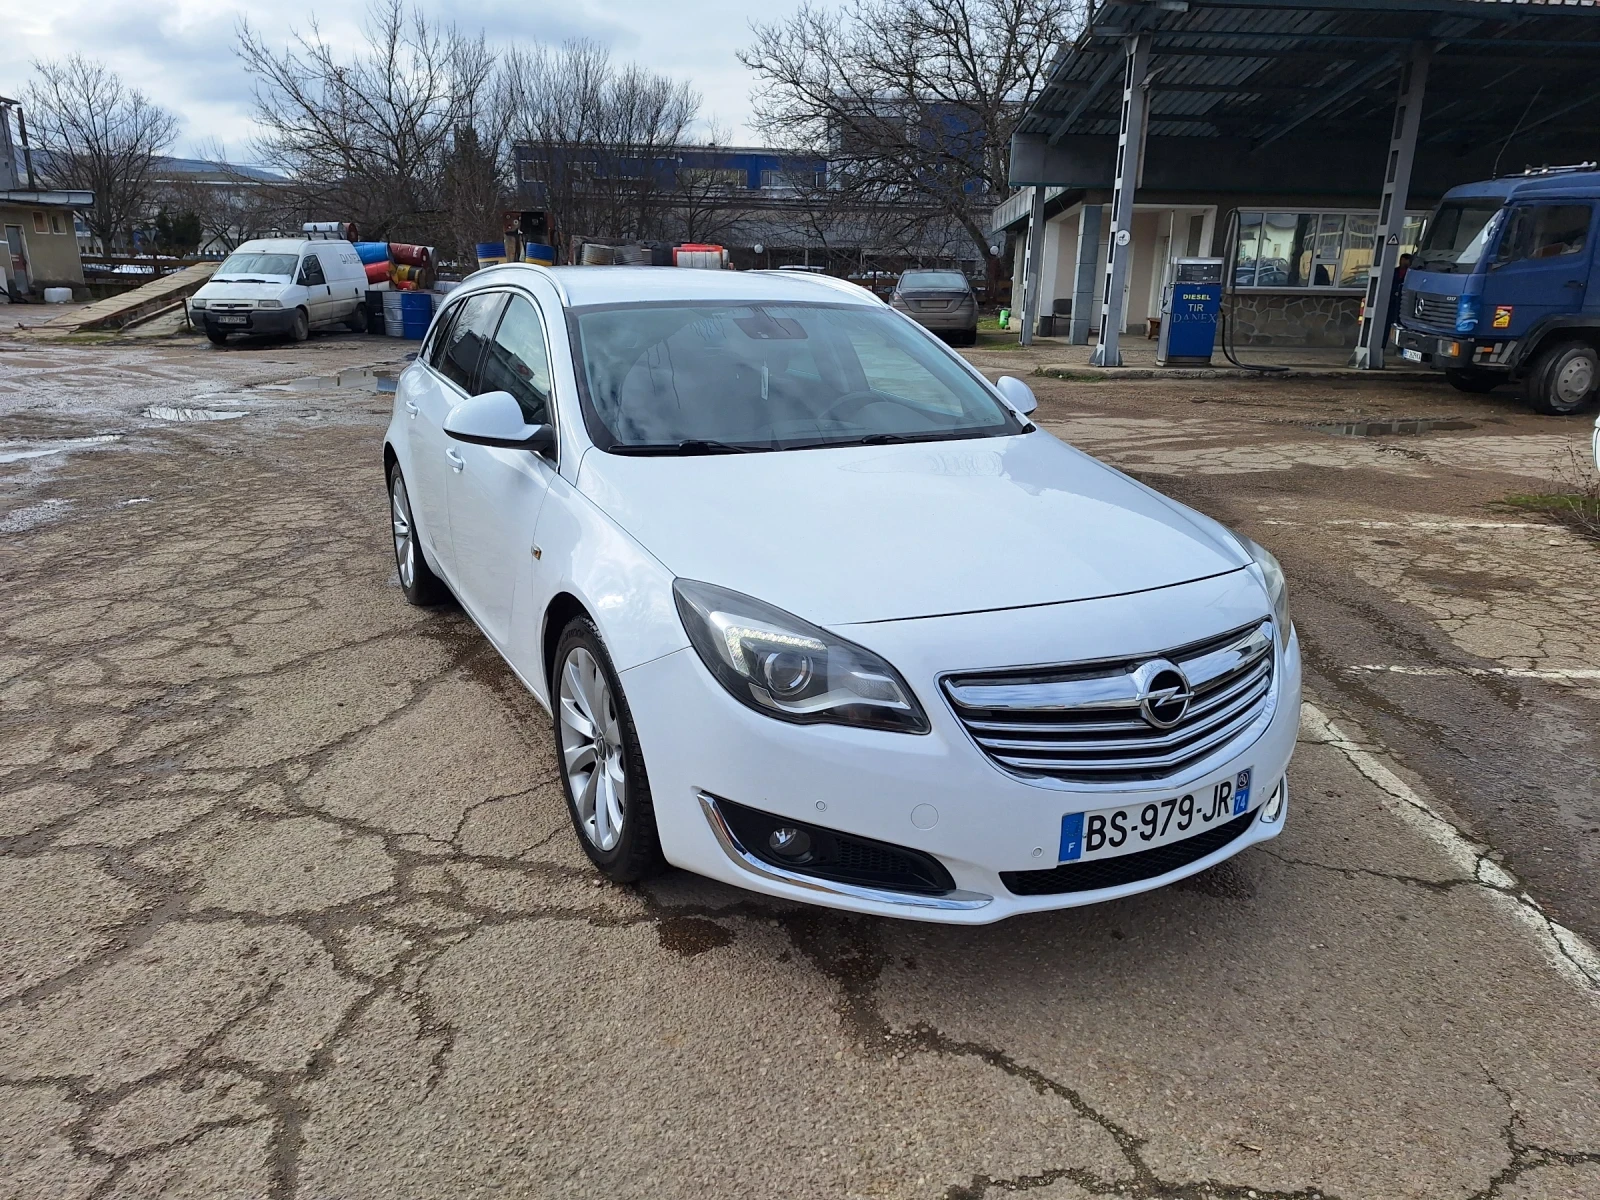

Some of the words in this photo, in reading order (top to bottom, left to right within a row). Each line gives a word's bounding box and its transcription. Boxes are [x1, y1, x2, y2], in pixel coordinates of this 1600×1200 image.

[1188, 303, 1204, 312] TIR
[1173, 314, 1217, 323] DANEX
[1068, 842, 1076, 853] F
[1086, 781, 1232, 852] BS-979-JR
[1235, 794, 1246, 811] 74
